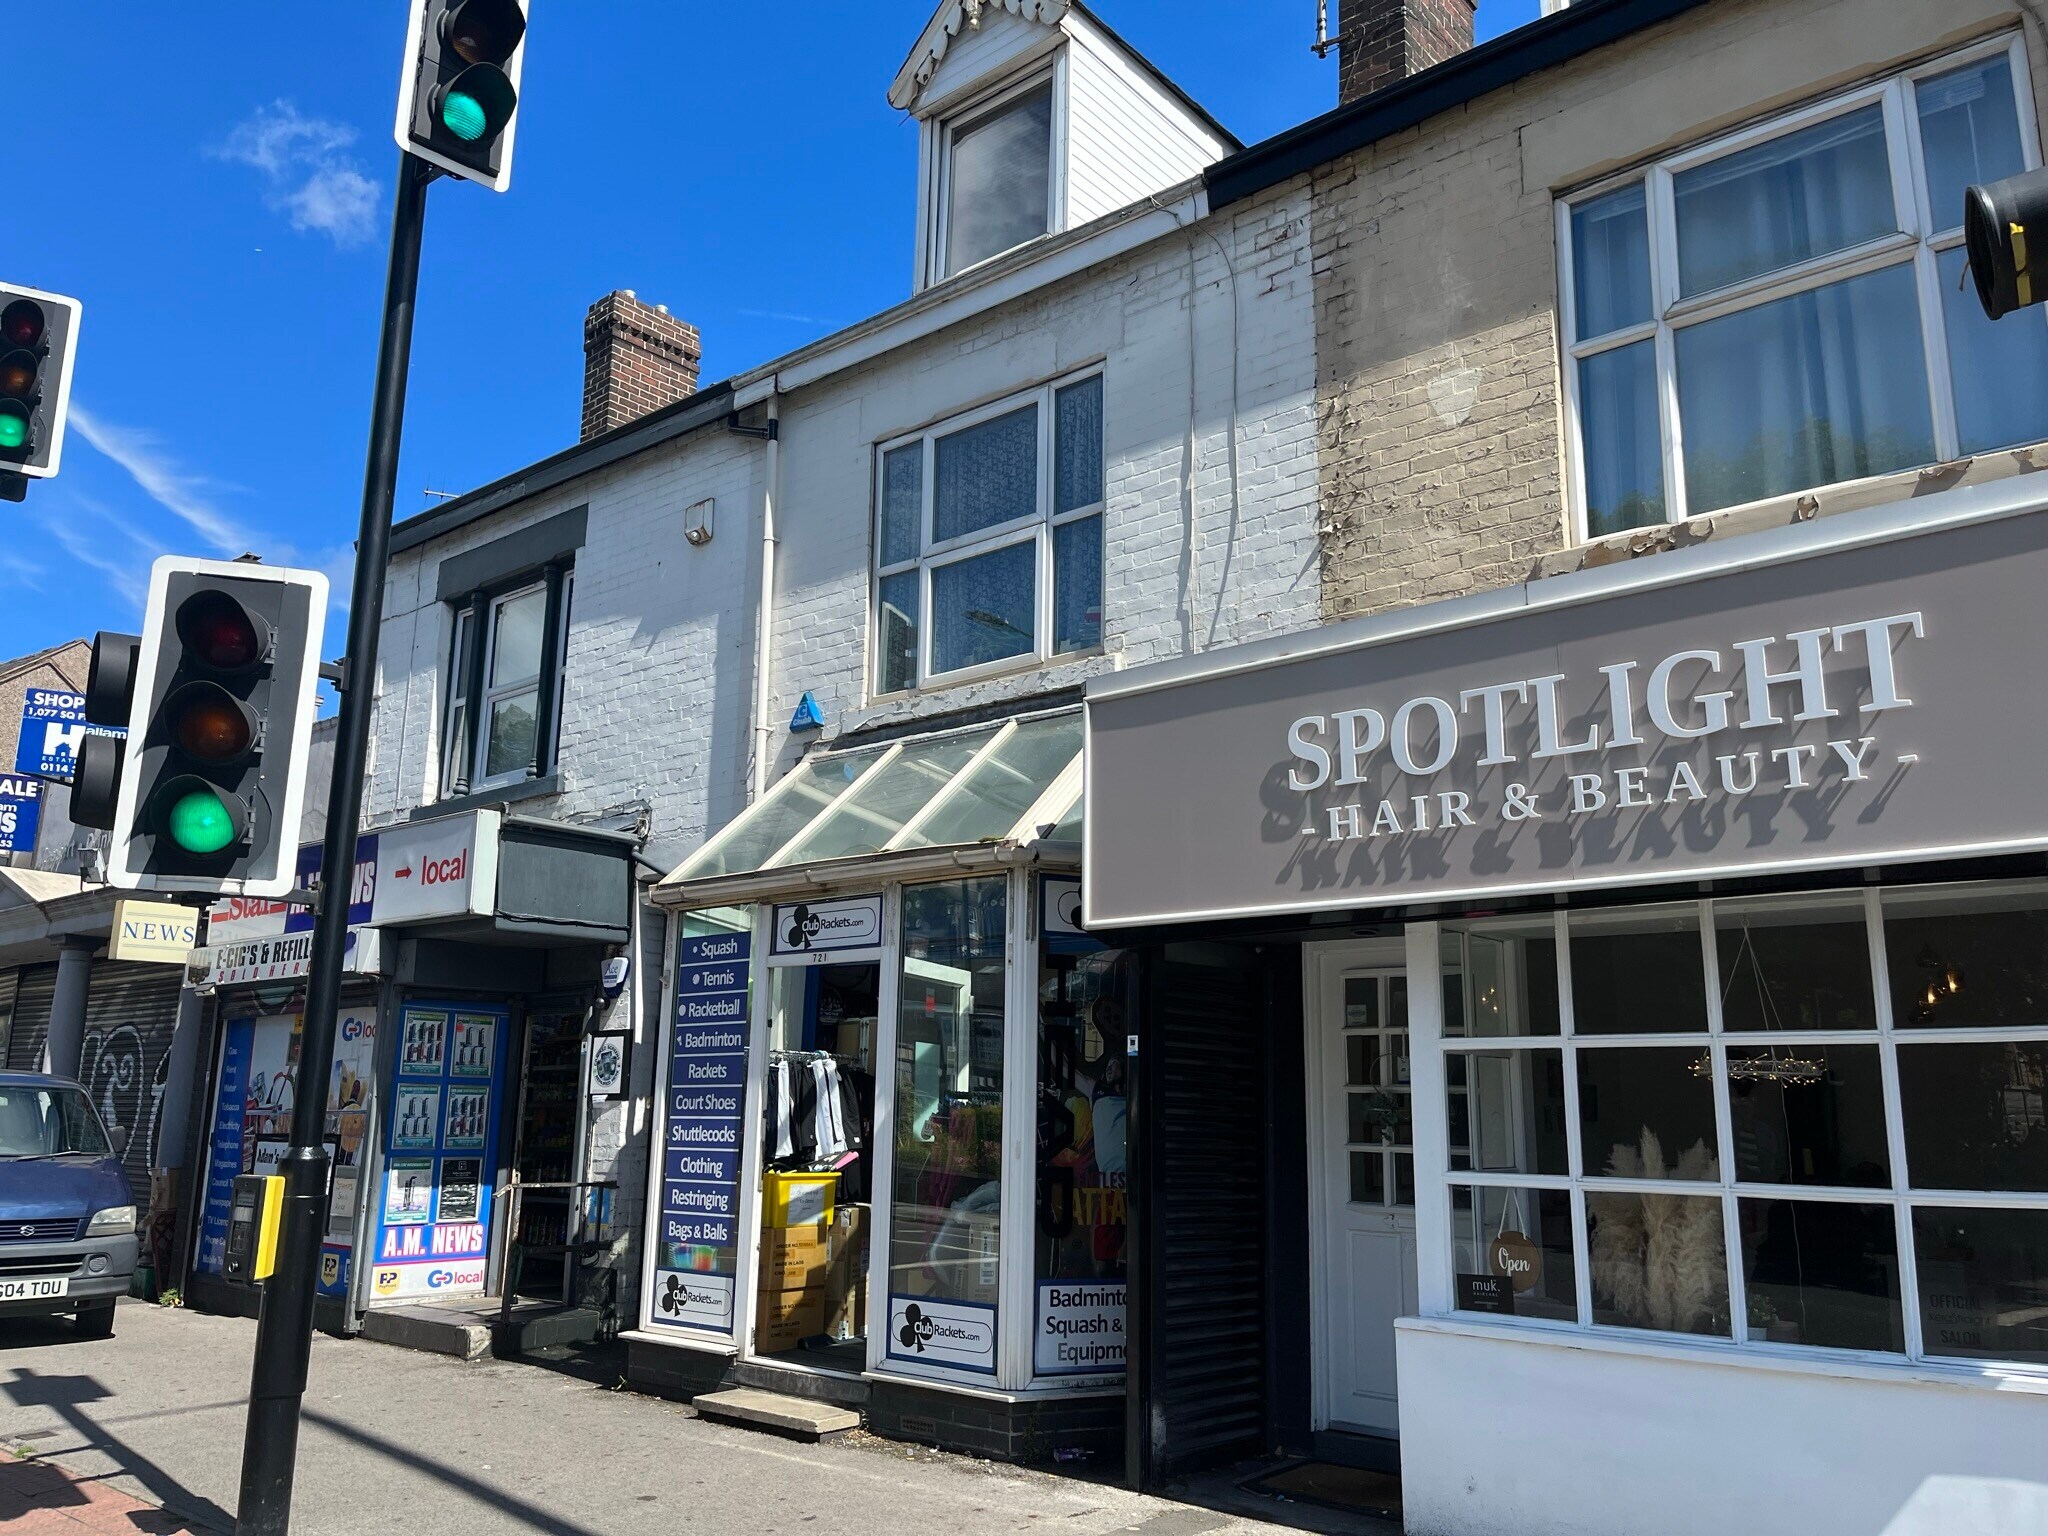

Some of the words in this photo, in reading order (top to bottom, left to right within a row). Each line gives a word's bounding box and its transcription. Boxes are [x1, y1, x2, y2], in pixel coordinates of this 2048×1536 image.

[33, 692, 86, 709] SHOP
[1287, 611, 1924, 792] SPOTLIGHT
[28, 707, 57, 718] 1,077
[60, 711, 76, 720] SQ
[78, 713, 86, 721] F
[40, 762, 69, 773] 0114
[0, 778, 38, 798] ALE
[1326, 791, 1476, 842] HAIR
[1501, 783, 1542, 821] &
[1569, 737, 1876, 815] BEAUTY
[421, 848, 468, 885] local
[122, 921, 195, 943] NEWS
[802, 916, 864, 932] ClubRackets.com
[701, 938, 738, 956] Squash
[216, 943, 257, 970] E-CIG'S
[260, 943, 269, 964] &
[812, 953, 827, 963] 721
[218, 966, 259, 983] SOLD
[268, 960, 311, 977] HERE
[702, 969, 735, 986] Tennis
[688, 999, 740, 1018] Racketball
[362, 1021, 376, 1038] loc
[685, 1031, 742, 1048] Badminton
[228, 1047, 238, 1055] Gas
[688, 1063, 727, 1079] Rackets
[222, 1102, 240, 1111] Tobacco
[675, 1094, 704, 1110] Court
[705, 1092, 736, 1110] Shoes
[219, 1122, 240, 1132] Electricity
[672, 1124, 736, 1143] Shuttlecocks
[218, 1140, 239, 1151] Telephone
[214, 1159, 237, 1170] Magazines
[256, 1148, 280, 1164] Adam's
[680, 1157, 723, 1179] Clothing
[212, 1178, 229, 1187] Council
[671, 1189, 729, 1211] Restringing
[207, 1216, 214, 1224] TV
[214, 1217, 229, 1226] Licenc
[668, 1220, 692, 1242] Bags
[693, 1224, 702, 1239] &
[703, 1223, 728, 1242] Balls
[205, 1235, 219, 1245] Phone
[383, 1228, 427, 1257] A.M.
[431, 1225, 484, 1254] NEWS
[1498, 1246, 1530, 1277] Open
[454, 1270, 484, 1284] local
[31, 1281, 62, 1296] TOU
[672, 1289, 723, 1306] ClubRackets.com
[1930, 1294, 1984, 1310] OFFICIAL
[914, 1320, 980, 1342] ClubRackets.com
[1046, 1313, 1108, 1339] Squash
[1112, 1318, 1123, 1333] &
[1940, 1330, 1982, 1345] SALON
